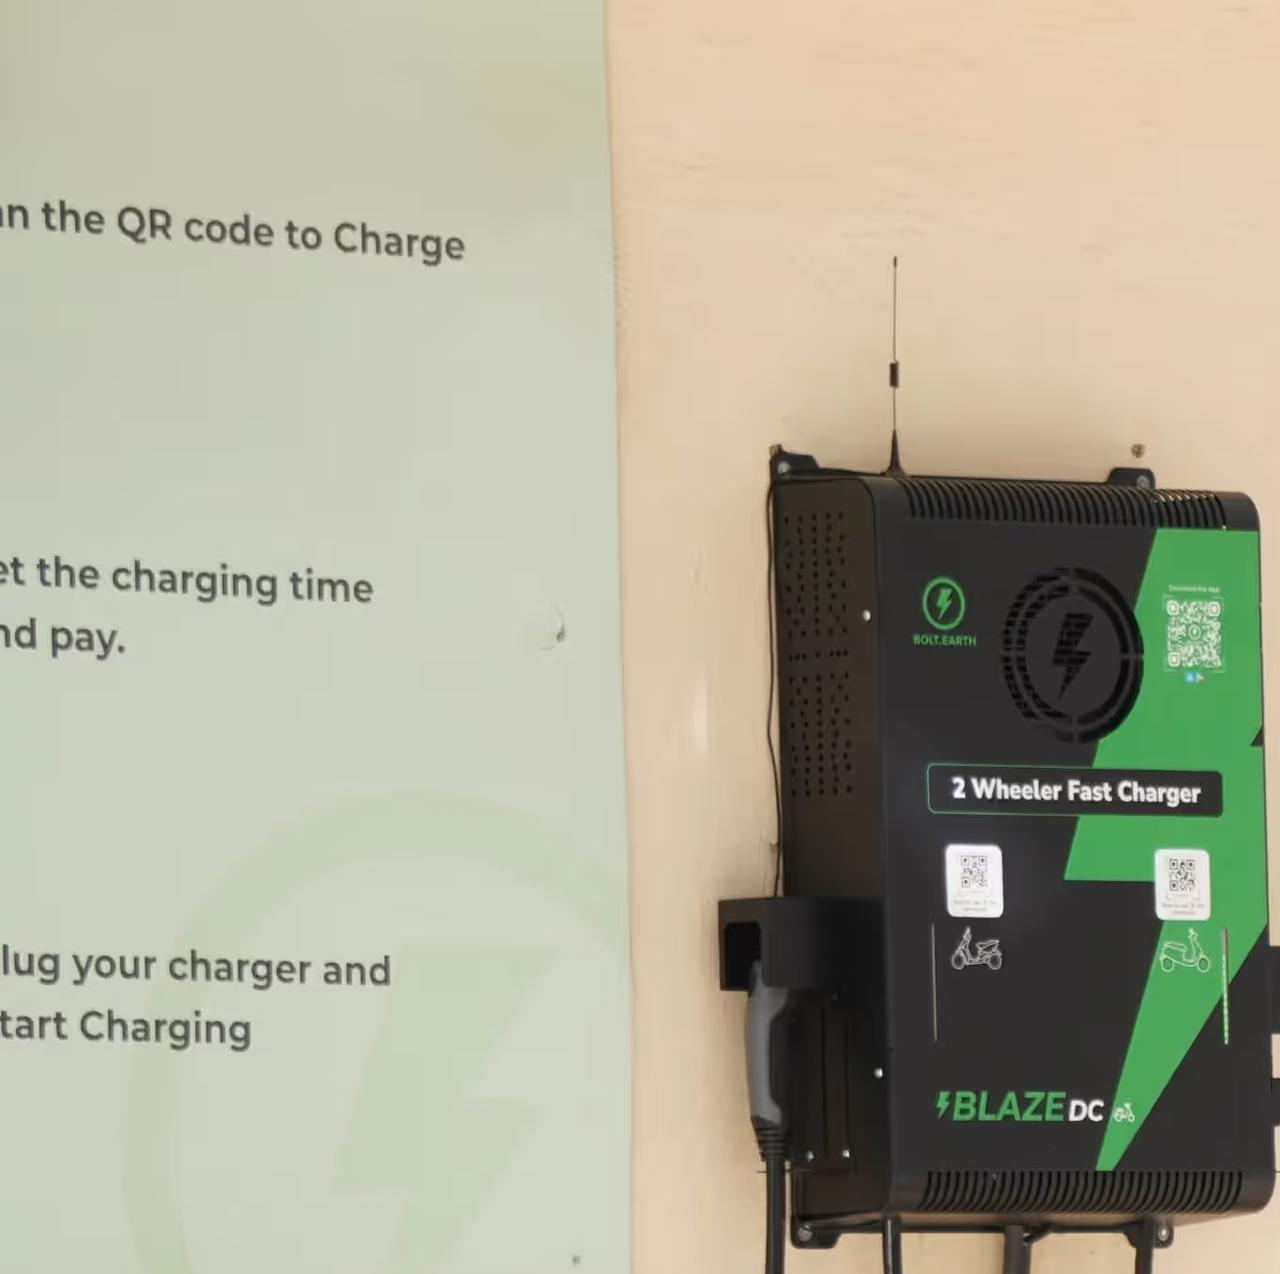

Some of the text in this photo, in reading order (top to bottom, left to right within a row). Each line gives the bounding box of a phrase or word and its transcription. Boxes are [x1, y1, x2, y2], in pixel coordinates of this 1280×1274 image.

[41, 200, 105, 234] the
[118, 207, 171, 243] QR
[185, 214, 274, 246] code
[285, 221, 322, 250] to
[335, 222, 465, 266] Charge
[37, 556, 99, 589] the
[112, 560, 277, 606] charging
[289, 568, 373, 603] time
[51, 627, 124, 660] pay.
[912, 634, 977, 647] BOLT.EARTH
[952, 777, 1201, 807] 2 Wheeler Fast Charger
[72, 955, 156, 985] your
[169, 949, 311, 990] charger
[324, 955, 390, 985] and
[80, 1009, 250, 1052] Charging
[952, 1091, 1104, 1122] BLAZE DC
